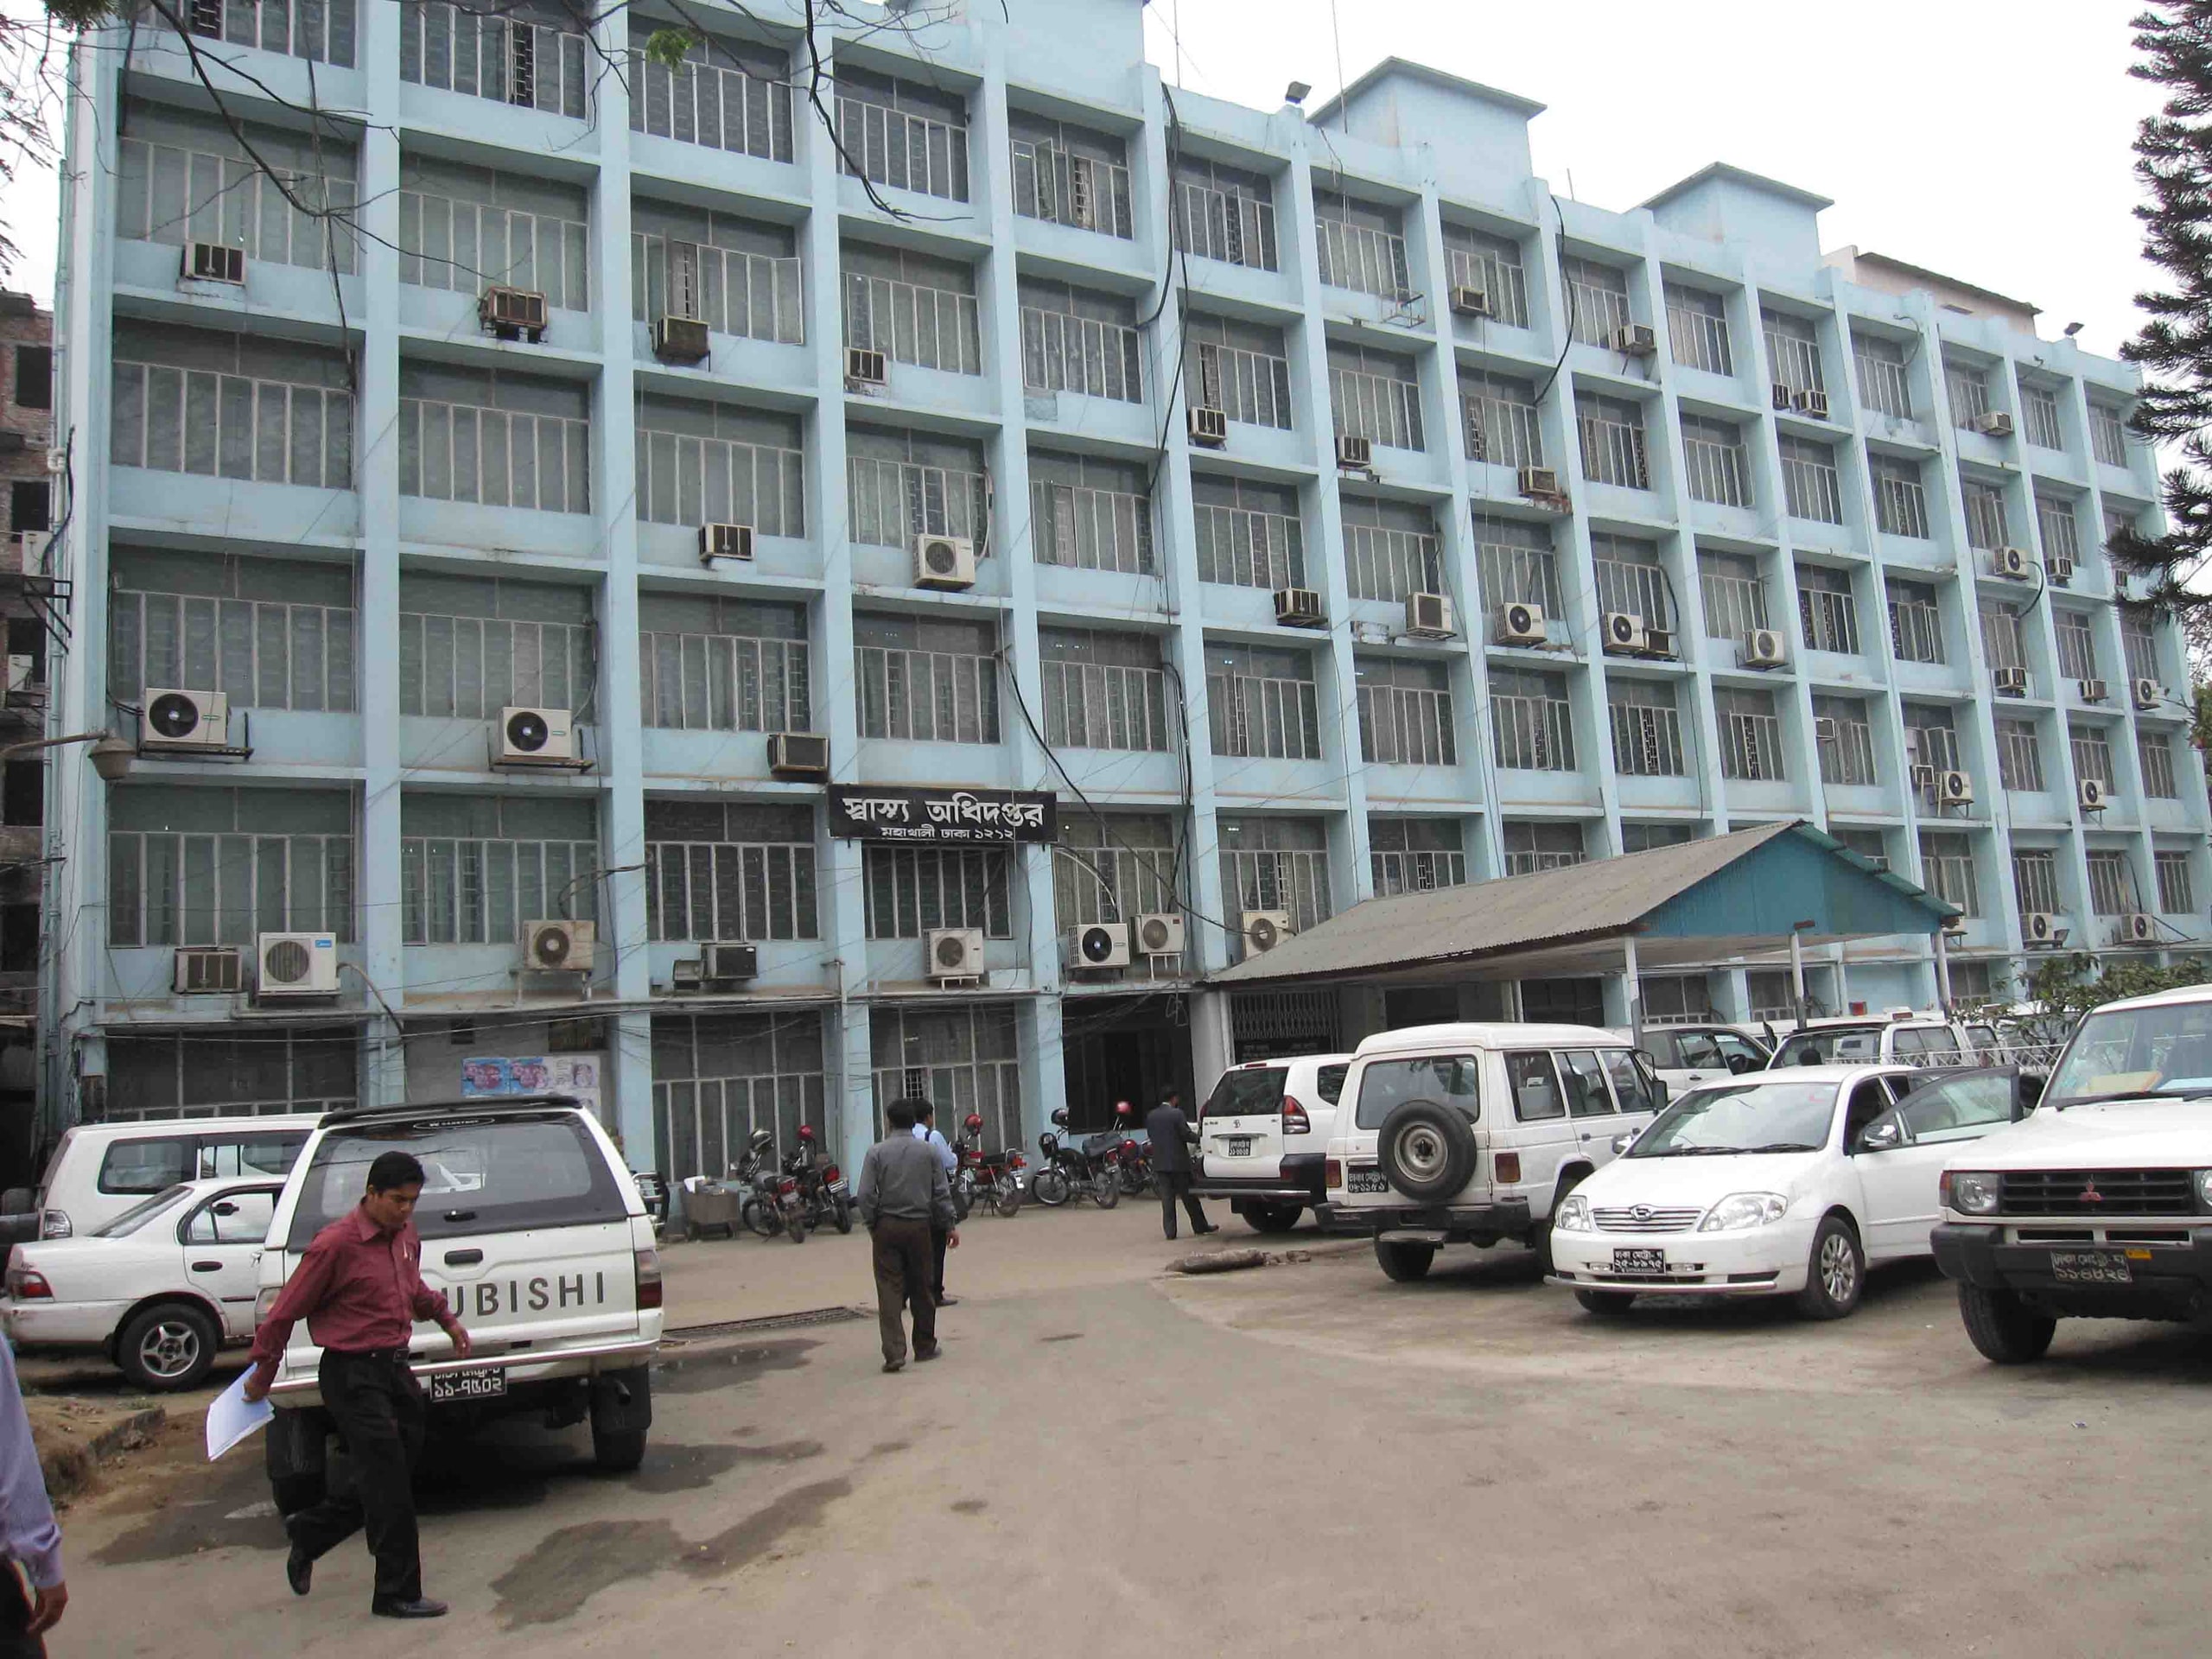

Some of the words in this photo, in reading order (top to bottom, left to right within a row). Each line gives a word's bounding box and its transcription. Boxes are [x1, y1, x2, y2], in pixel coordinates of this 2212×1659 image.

[925, 791, 1044, 827] অধিদপ্তর
[880, 823, 936, 837] মহাখালী
[940, 829, 970, 839] ঢাকা
[975, 830, 1014, 840] ১২১২
[442, 1272, 604, 1317] UBISHI
